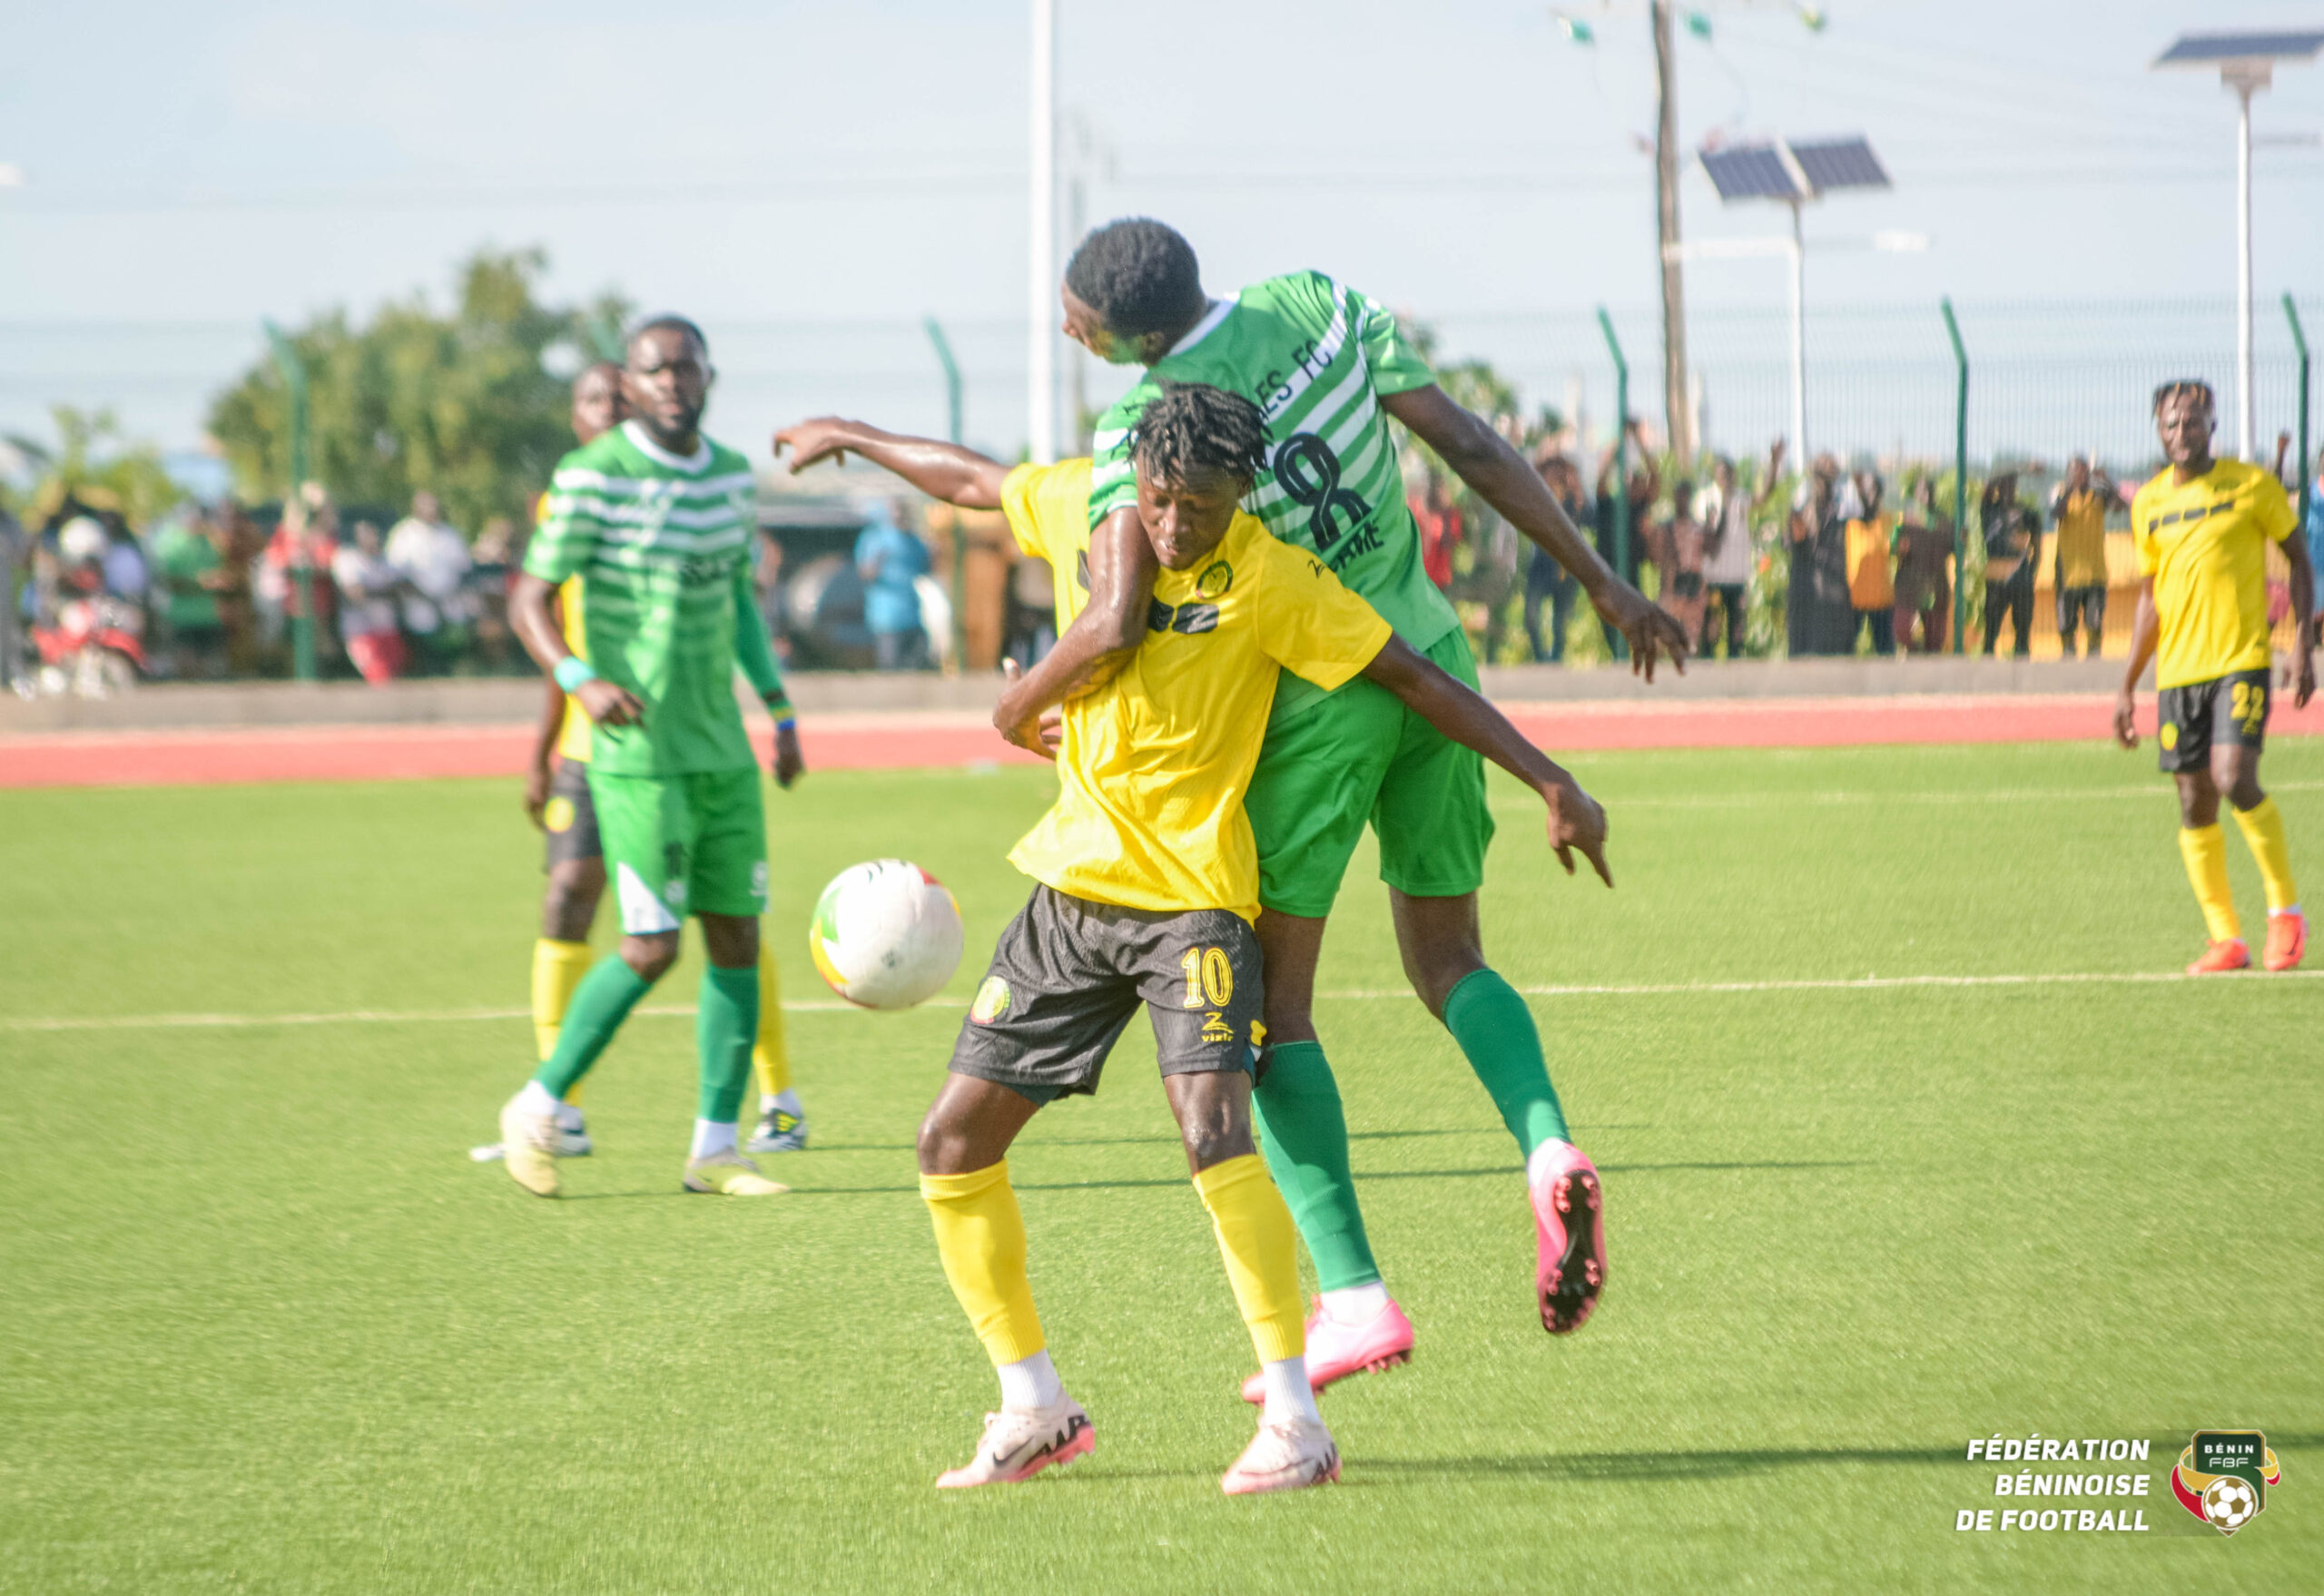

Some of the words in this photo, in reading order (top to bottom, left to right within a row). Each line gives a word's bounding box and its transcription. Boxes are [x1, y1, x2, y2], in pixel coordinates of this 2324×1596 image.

[1292, 339, 1333, 380] FC
[1273, 431, 1372, 552] 8
[2230, 680, 2265, 722] 22
[1181, 946, 1234, 1009] 10
